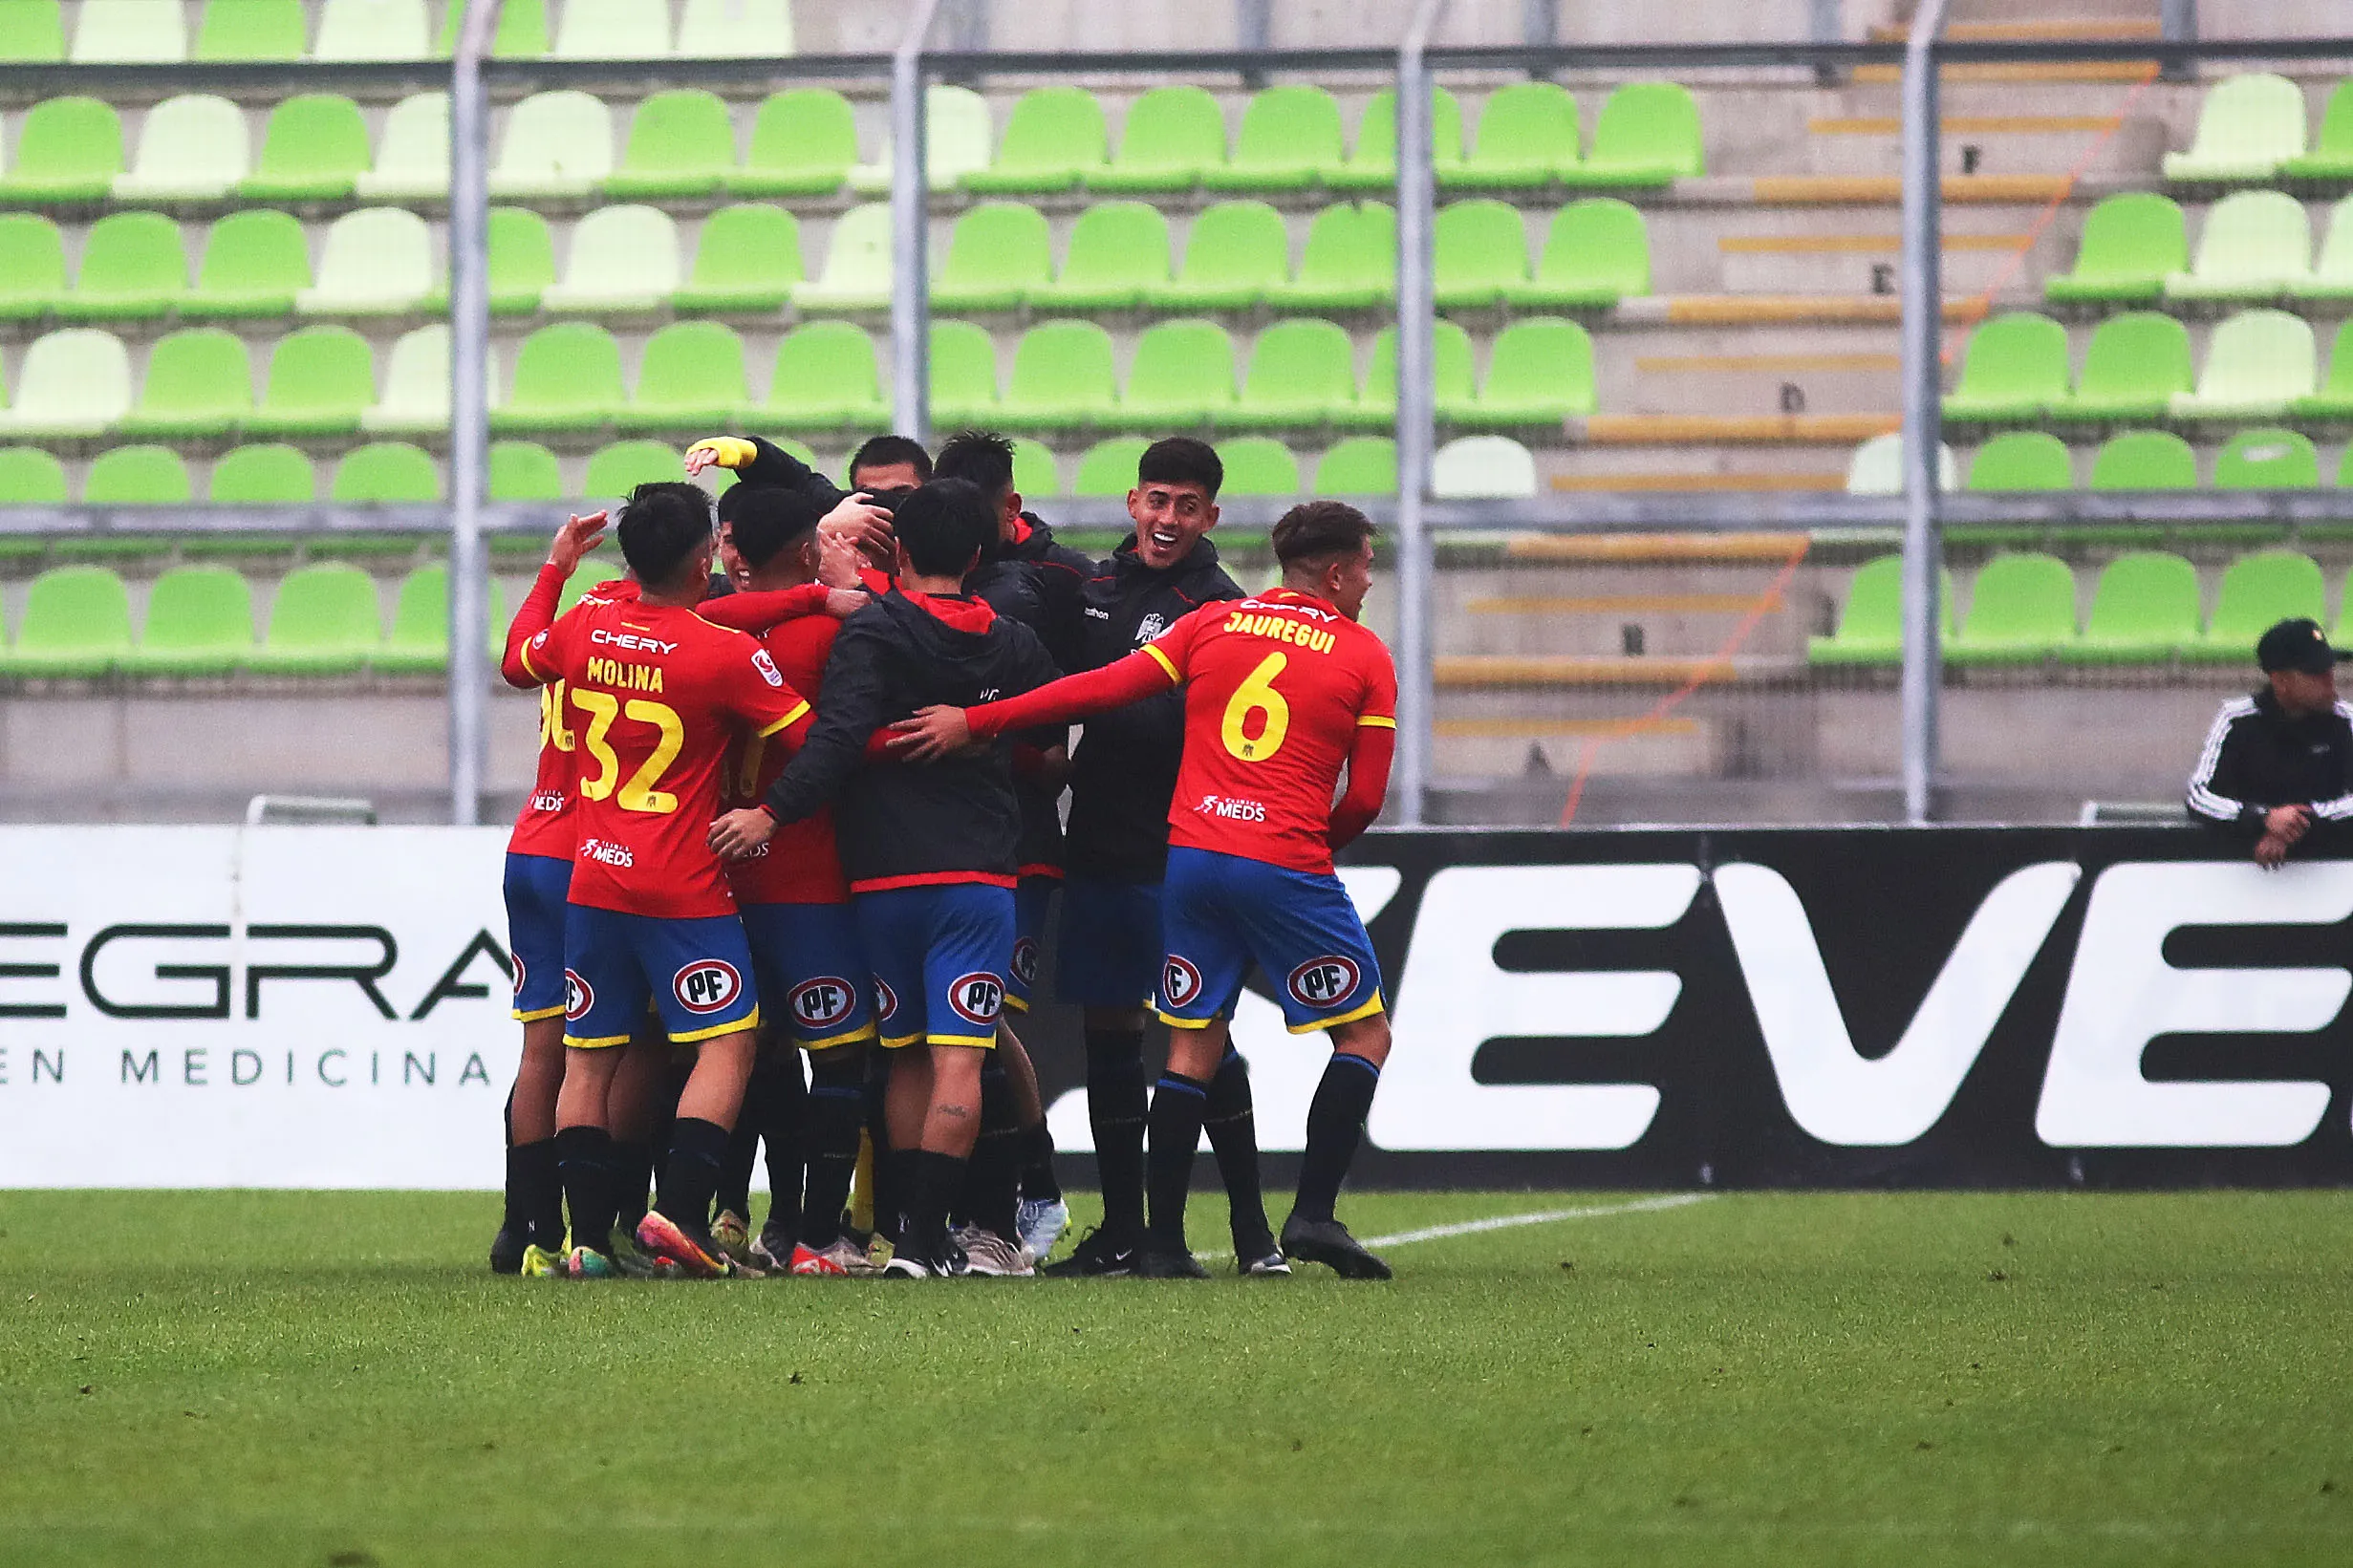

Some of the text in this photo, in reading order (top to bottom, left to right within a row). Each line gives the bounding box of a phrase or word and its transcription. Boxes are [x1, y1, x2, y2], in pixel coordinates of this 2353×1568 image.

[591, 629, 679, 655] CHERY
[1223, 611, 1336, 655] JAUREGUI
[588, 655, 663, 694] MOLINA
[1221, 652, 1289, 763] 6
[571, 687, 684, 812] 32
[1217, 801, 1266, 823] MEDS
[593, 846, 634, 868] MEDS
[686, 970, 723, 1003] PF
[967, 981, 1000, 1015] PF
[1303, 965, 1342, 999] PF
[801, 986, 839, 1017] PF
[1046, 861, 2353, 1149] EVE
[120, 1048, 491, 1086] MEDICINA
